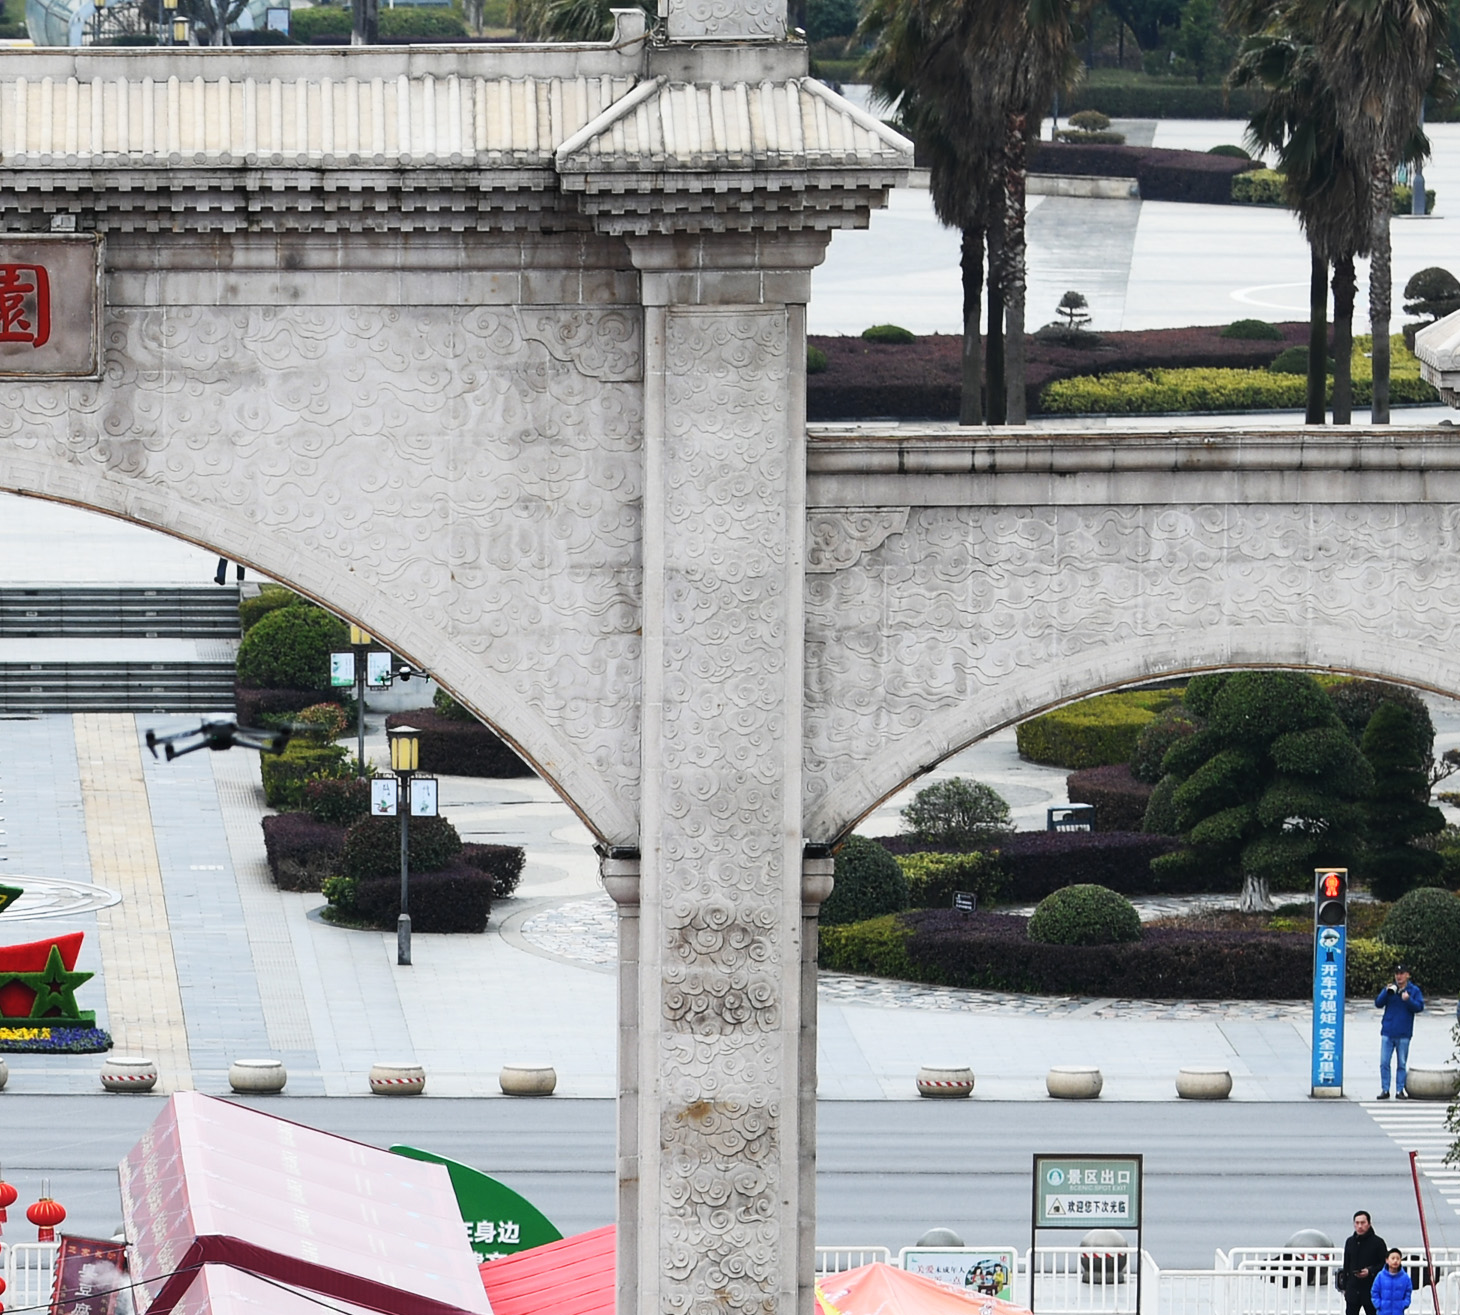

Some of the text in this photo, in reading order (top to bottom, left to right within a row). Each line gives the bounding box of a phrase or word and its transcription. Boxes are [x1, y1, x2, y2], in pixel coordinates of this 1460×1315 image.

[1318, 964, 1338, 1083] 开车守规矩 安全万里行
[1067, 1169, 1130, 1184] 景区出口
[1068, 1201, 1126, 1213] 欢迎您下次光临
